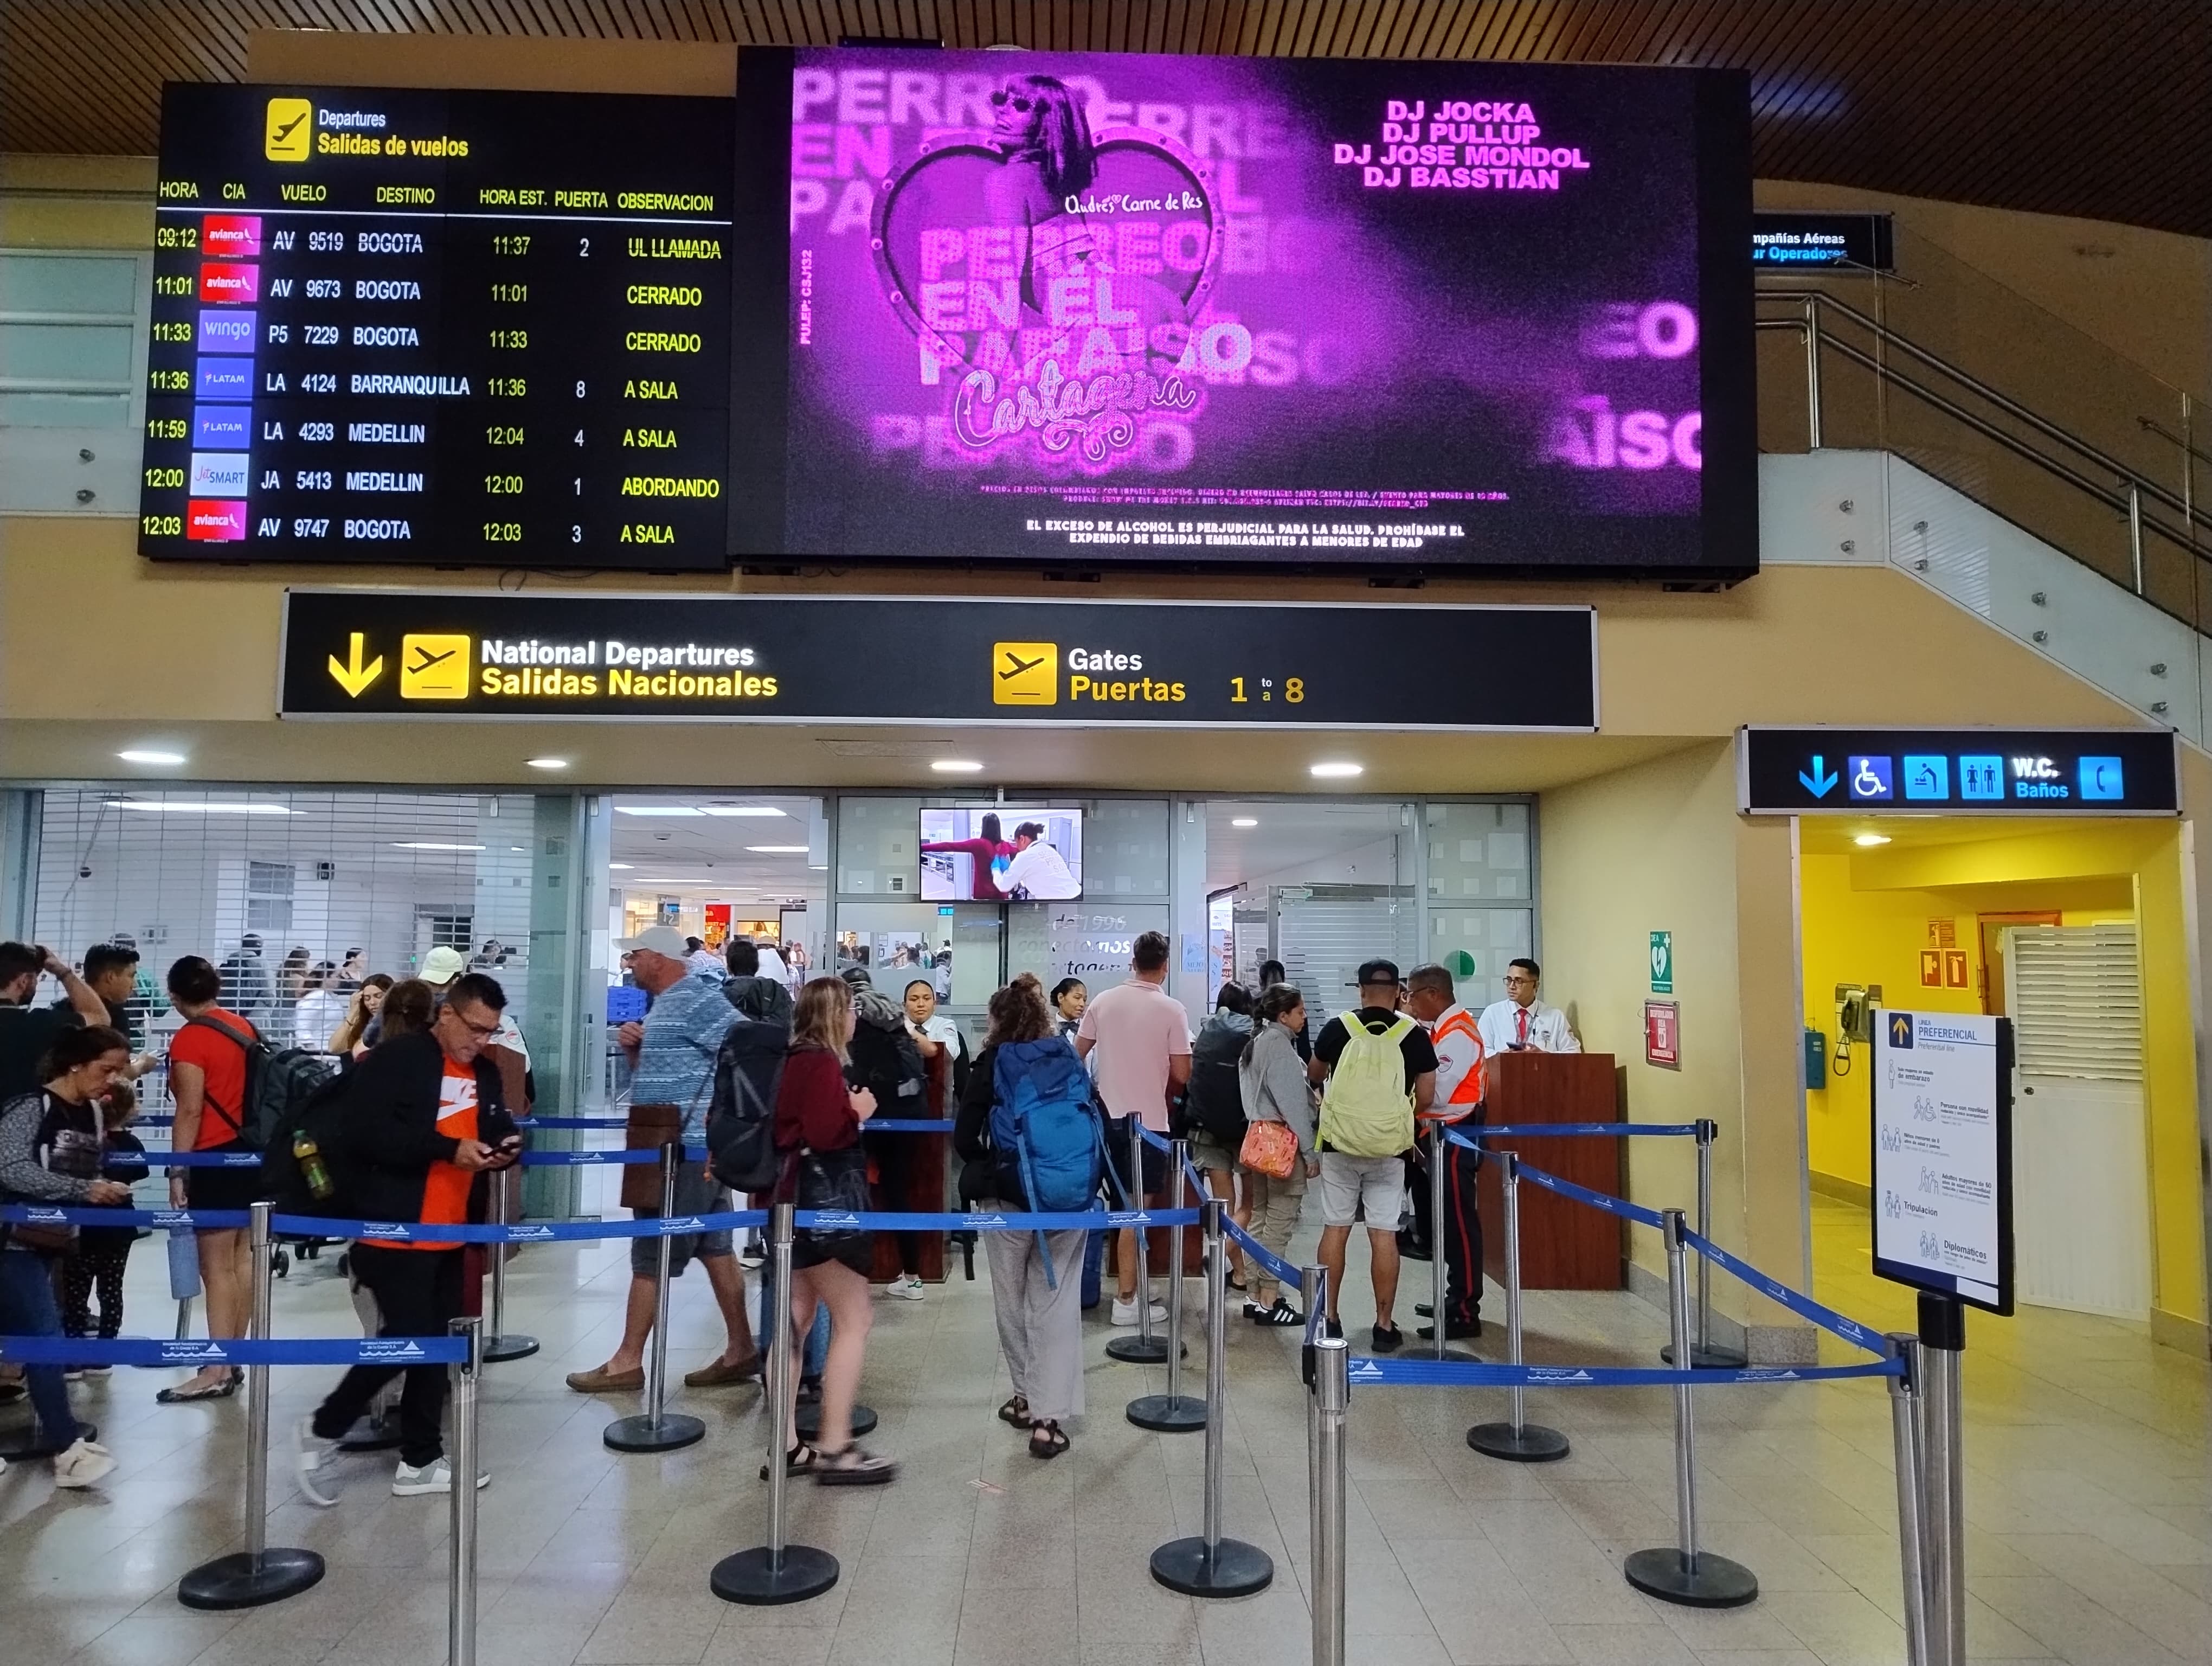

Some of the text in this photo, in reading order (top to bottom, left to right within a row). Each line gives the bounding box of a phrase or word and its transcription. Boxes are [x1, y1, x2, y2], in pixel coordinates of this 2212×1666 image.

[319, 109, 385, 129] Departures
[1388, 100, 1535, 123] DJ JOCKA
[318, 133, 468, 156] Salidas de vuelos
[1383, 123, 1540, 145] DJ PULLUP
[1334, 144, 1590, 168] DJ JOSE MONDOL
[1364, 166, 1558, 190] DJ BASSTIAN
[160, 182, 713, 211] HORA CIA VUELO DESTINO HORA EST. PUERTA OBSERVACION
[1121, 194, 1161, 212] Carne
[1165, 193, 1179, 210] de
[1182, 191, 1203, 210] Res
[158, 228, 722, 259] 09:12 avianca AV 9519 BOGOTA 11:37 2 UL LLAMADA
[1803, 233, 1845, 244] Aéreas
[156, 275, 702, 306] 11:01 avianca AV 9673 BOGOTA 11:01 CERRADO
[801, 249, 812, 344] PULEP: CSJ132
[153, 322, 701, 353] 11:33 wingo P5 7229 BOGOTA 11:33 CERRADO
[151, 371, 678, 399] 11:36 LATAM LA 4124 BARRANQUILLA 11:36 8 A SALA
[148, 420, 677, 448] 11:59 LATAM LA 4293 MEDELLIN 12:04 4 A SALA
[145, 465, 719, 498] 12:00 JetSMART JA 5413 MEDELLIN 12:00 1 ABORDANDO
[143, 514, 674, 543] 12:03 avianca AV 9747 BOGOTA 12:03 3 A SALA
[1027, 520, 1464, 536] EL EXCESO DE ALCOHOL ES PERJUDICIAL PARA LA SALUD. PROHÍBASE EL
[1069, 533, 1423, 548] EXPENDIO DE BEBIDAS EMBRIAGANTES A MENORES DE EDAD
[482, 640, 754, 671] National Departures
[1069, 649, 1142, 671] Gates
[481, 668, 778, 697] Salidas Nacionales
[1071, 676, 1247, 702] Puertas 1
[1262, 678, 1272, 688] to
[1263, 678, 1304, 703] a 8
[2014, 758, 2059, 777] W.C.
[2017, 781, 2069, 798] Baños
[1919, 1027, 1977, 1040] PREFERENCIAL
[1942, 1173, 1957, 1181] Adultos
[1904, 1201, 1938, 1216] Tripulación
[1944, 1240, 1986, 1259] Diplomáticos
